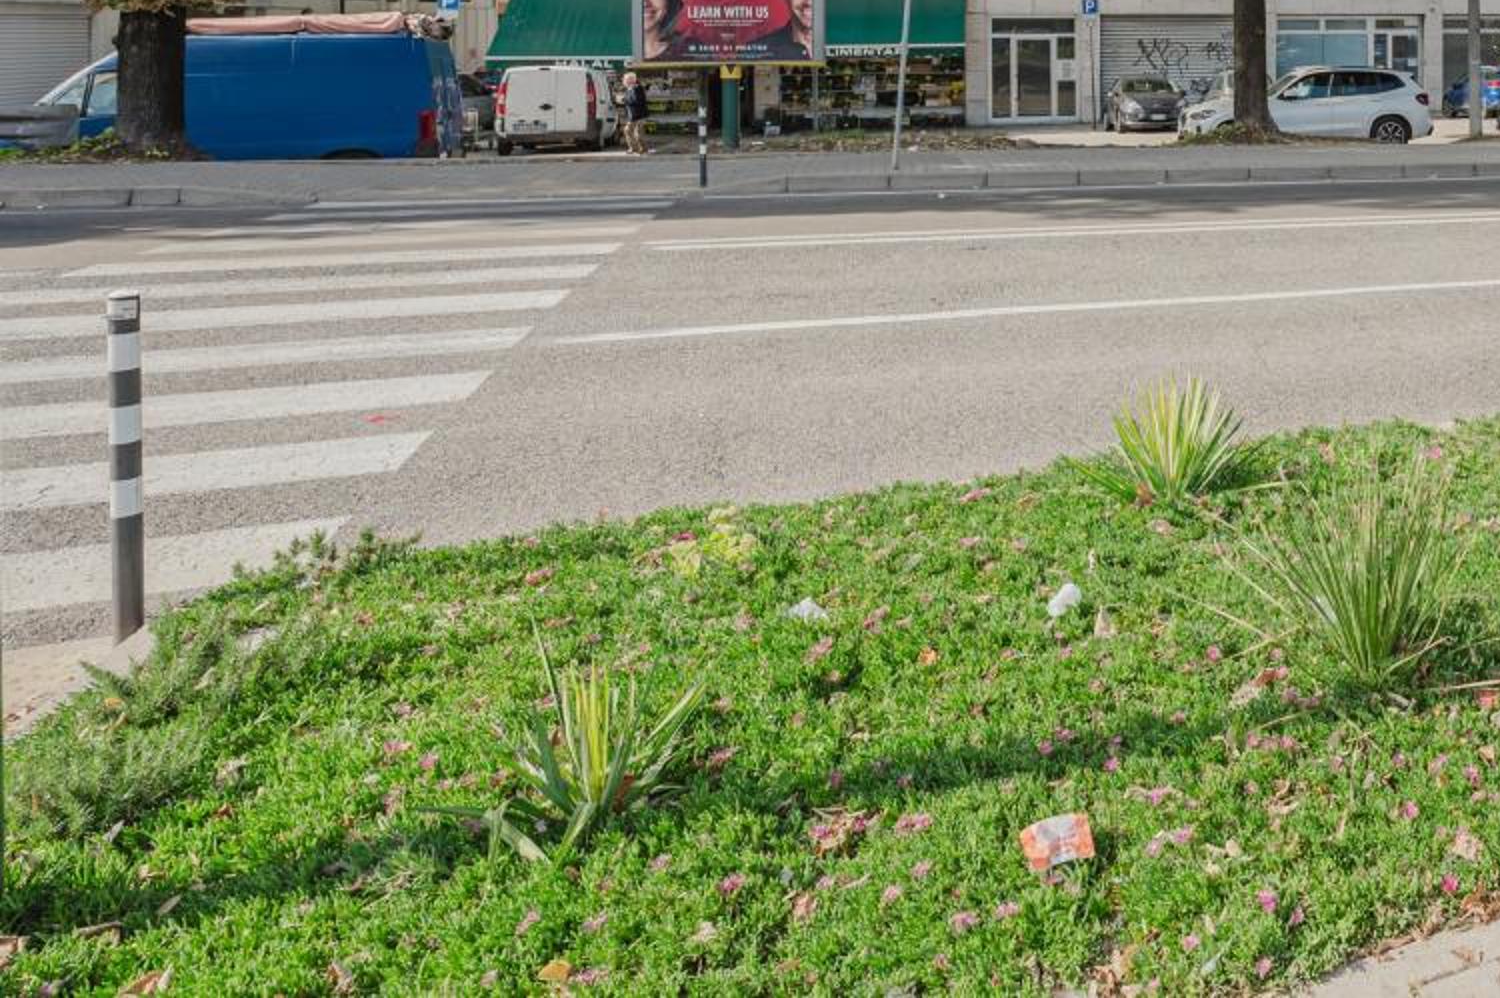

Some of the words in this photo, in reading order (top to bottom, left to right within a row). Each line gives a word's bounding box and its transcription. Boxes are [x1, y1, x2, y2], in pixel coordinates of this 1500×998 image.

[687, 5, 720, 19] LEARN
[724, 5, 752, 19] WITH
[756, 5, 769, 19] US
